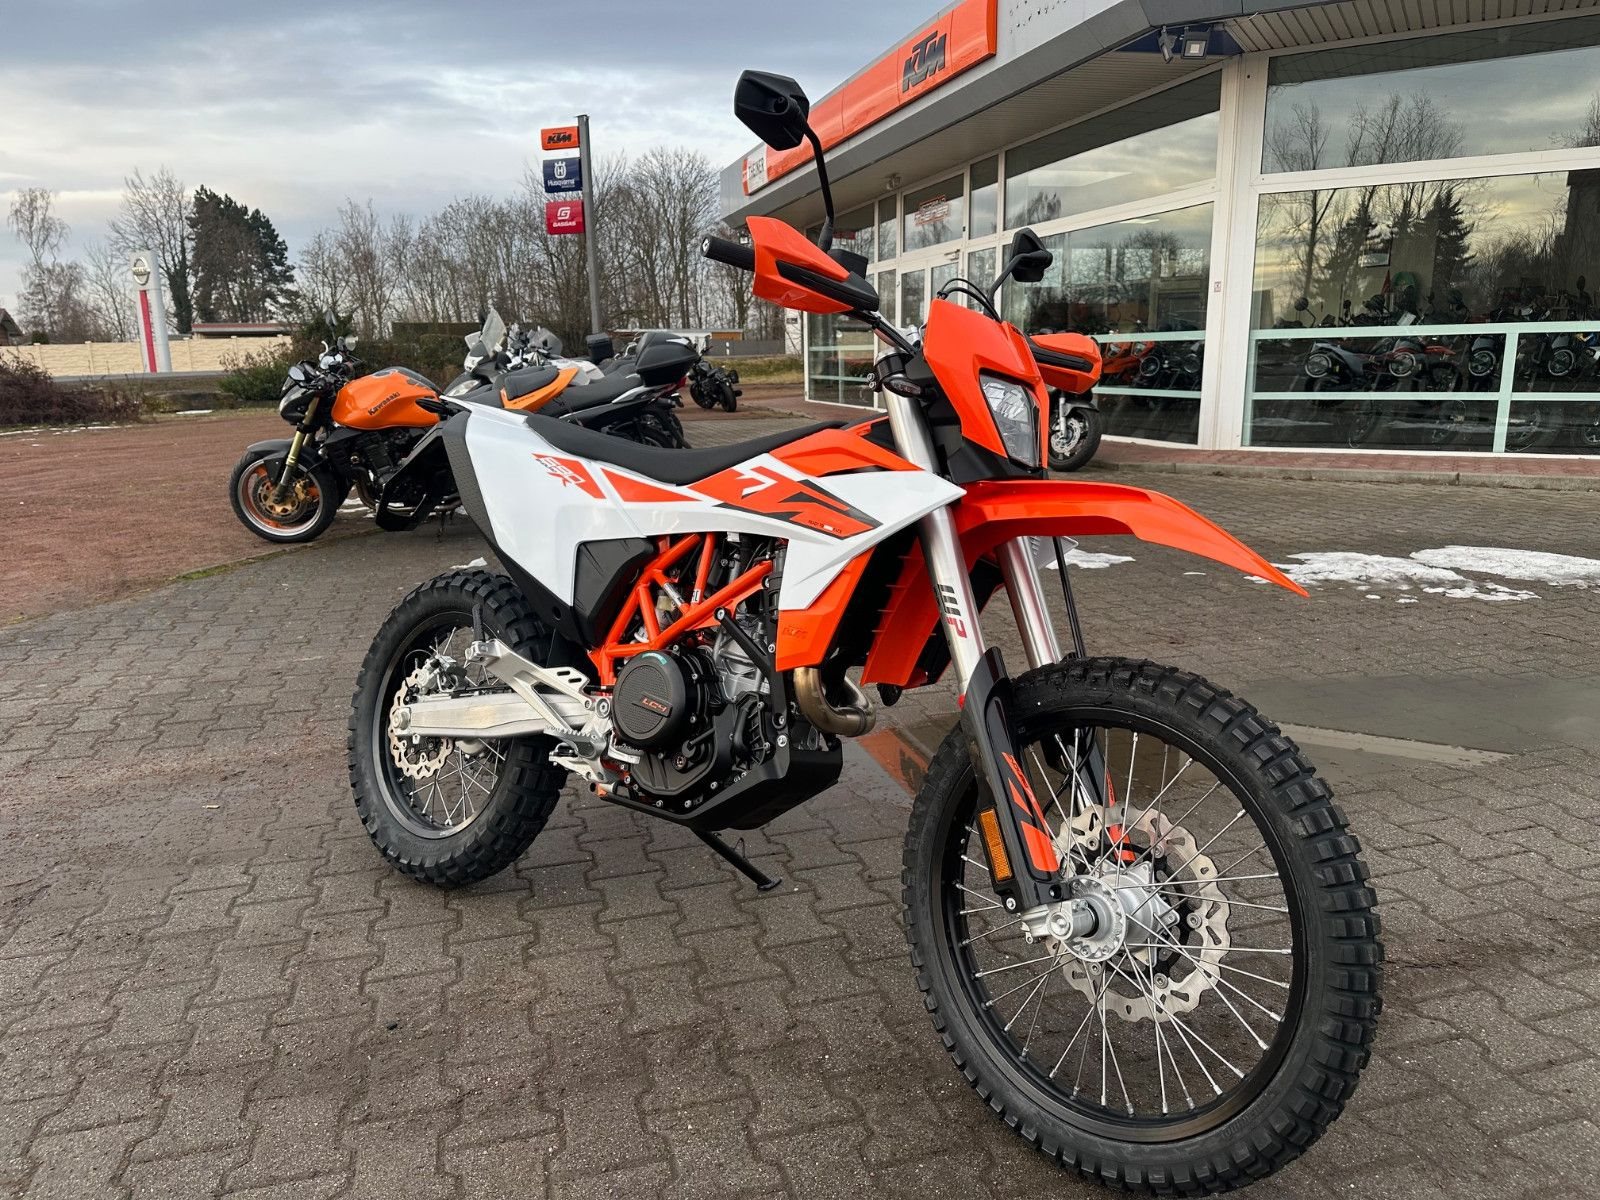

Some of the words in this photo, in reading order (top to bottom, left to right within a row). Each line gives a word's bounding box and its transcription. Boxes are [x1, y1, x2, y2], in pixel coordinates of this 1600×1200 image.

[902, 30, 947, 93] KTM
[547, 132, 572, 144] KTM
[547, 178, 575, 187] Husqvarna
[367, 391, 401, 416] Kawasaki
[641, 697, 667, 712] LC4
